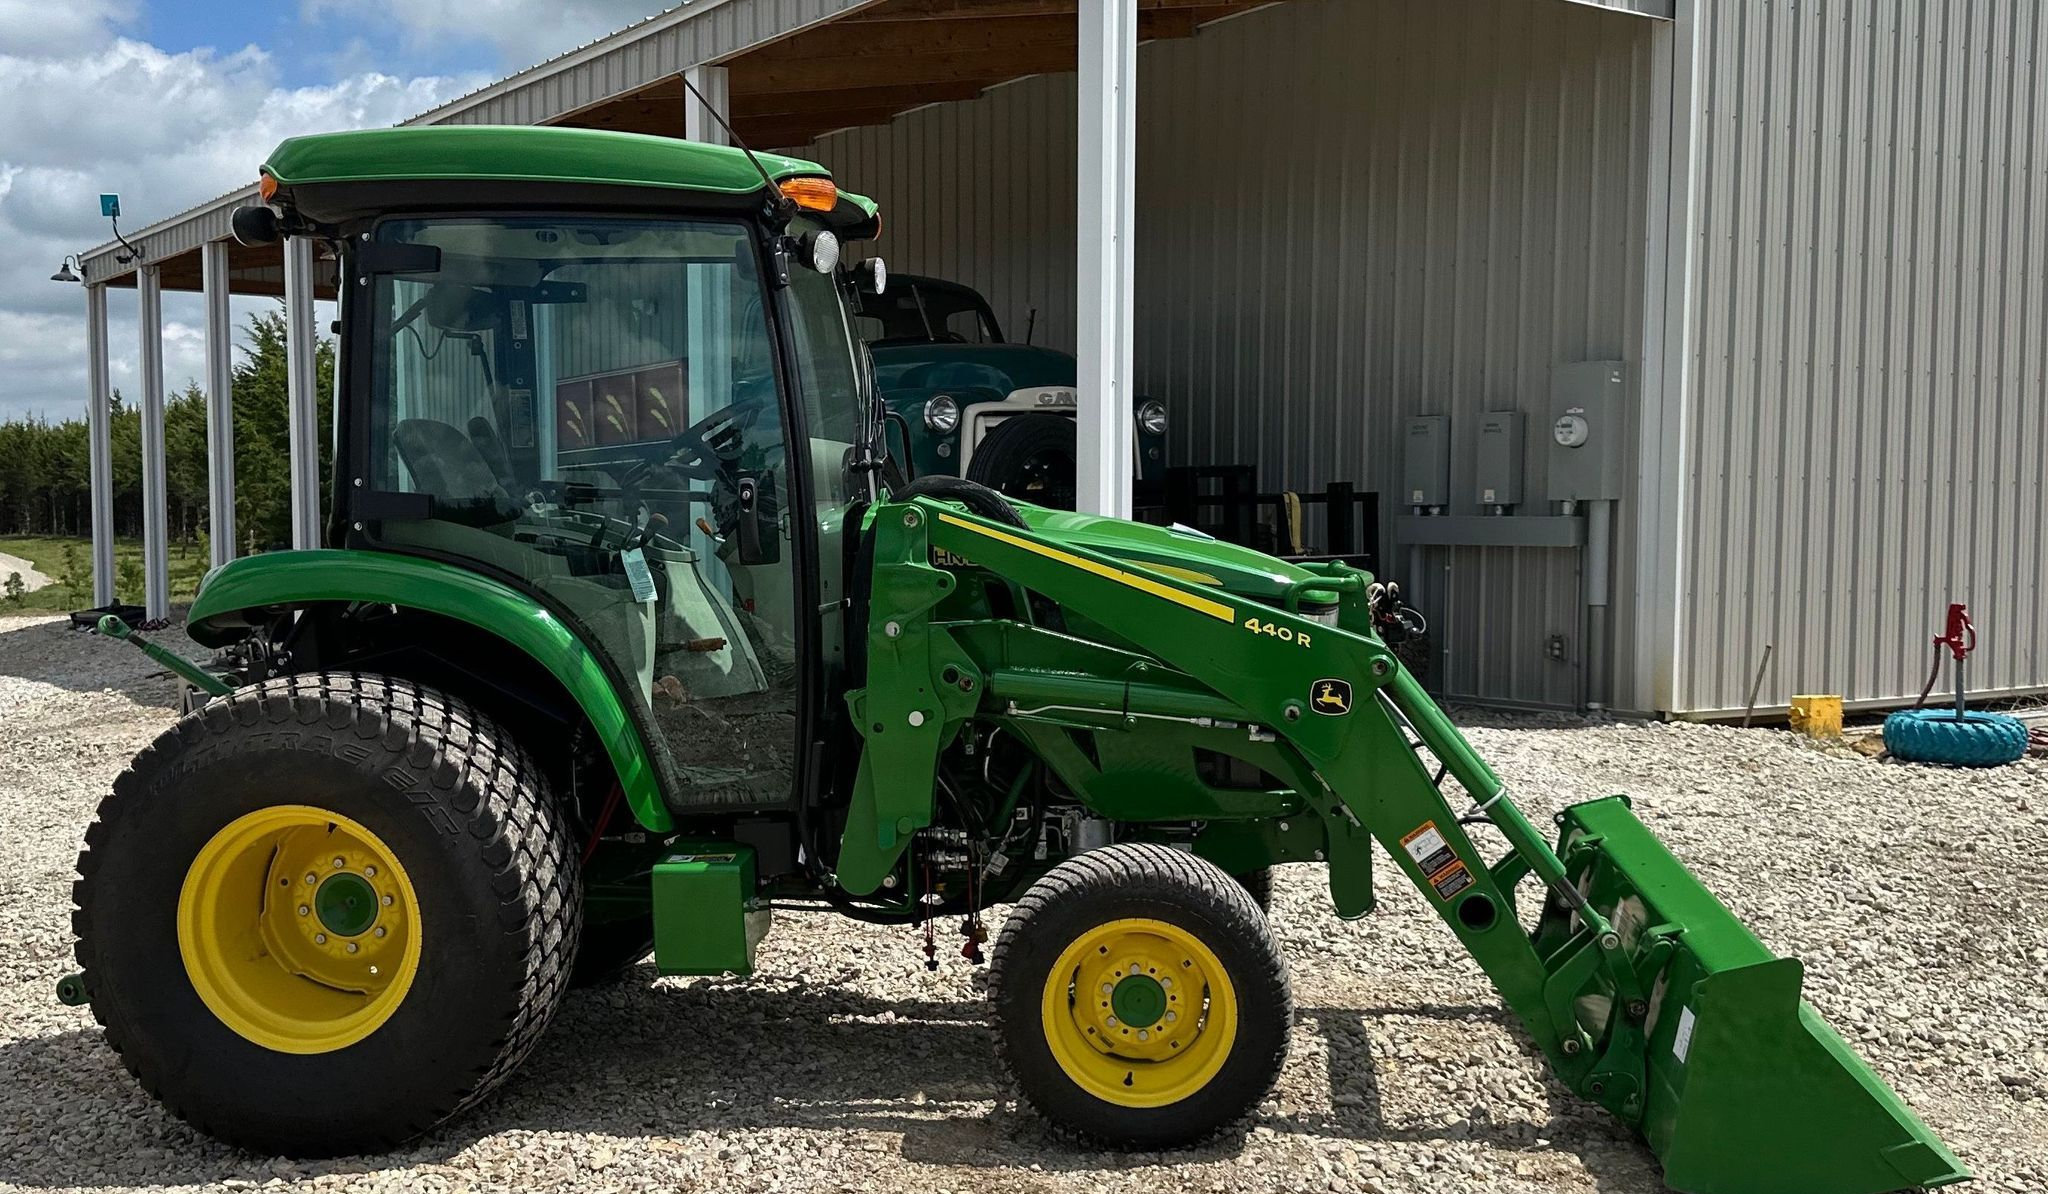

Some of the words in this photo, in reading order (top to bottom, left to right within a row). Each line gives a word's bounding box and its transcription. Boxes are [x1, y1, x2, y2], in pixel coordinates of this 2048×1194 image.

[1038, 391, 1077, 405] GM
[1244, 618, 1293, 641] 440
[1297, 632, 1311, 648] R
